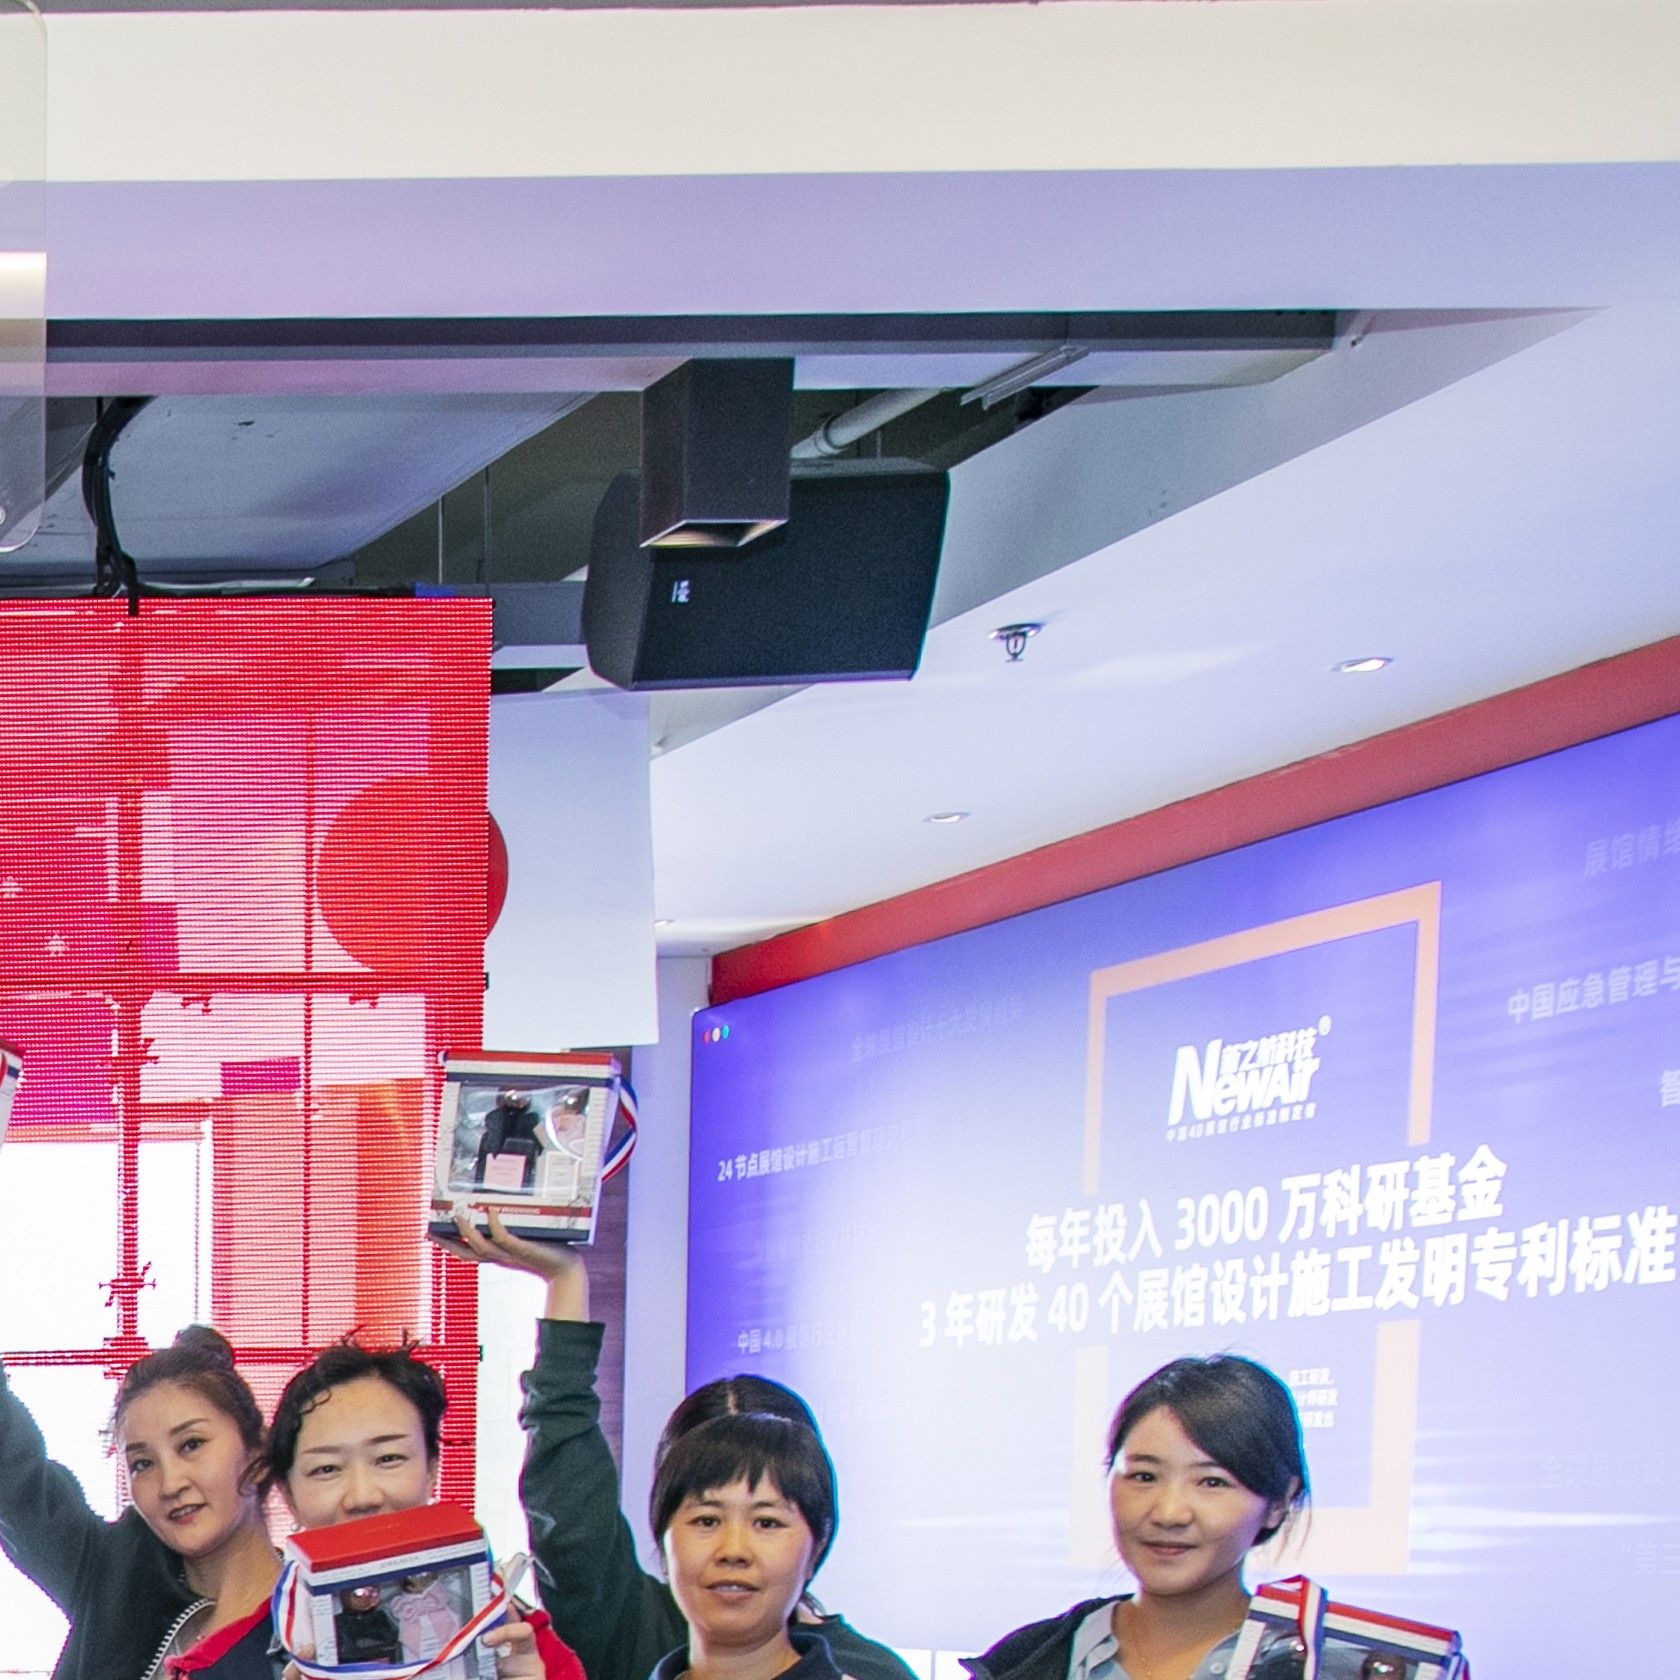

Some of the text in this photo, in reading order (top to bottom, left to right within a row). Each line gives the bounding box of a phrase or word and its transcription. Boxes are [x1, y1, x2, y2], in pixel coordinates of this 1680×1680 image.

[919, 1204, 1678, 1348] 3 年研发 40 个展馆设计施工发明专利标准
[1026, 1143, 1508, 1273] 每年投入 3000 万科研基金
